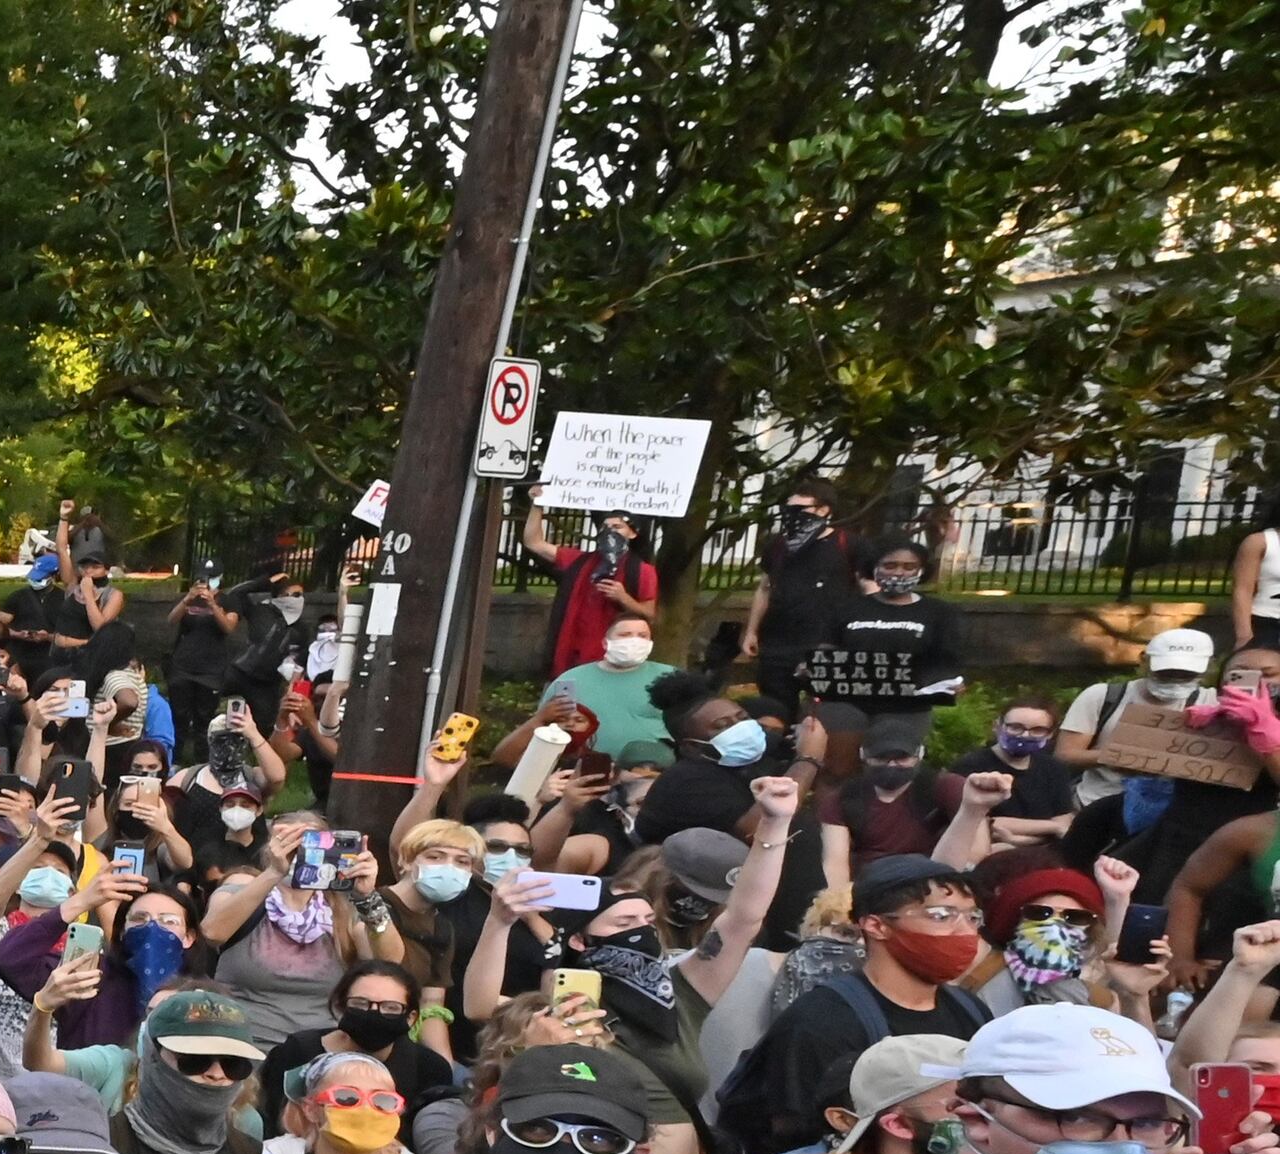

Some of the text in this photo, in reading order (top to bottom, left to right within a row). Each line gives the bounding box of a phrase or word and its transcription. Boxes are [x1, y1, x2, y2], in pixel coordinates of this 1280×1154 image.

[564, 422, 612, 444] When
[647, 432, 687, 451] power
[585, 445, 662, 465] of the people
[576, 461, 646, 478] is equal to
[586, 479, 640, 493] entrusted
[642, 482, 669, 495] with
[559, 490, 596, 506] there
[605, 497, 617, 507] is
[382, 530, 412, 554] 40
[381, 555, 396, 576] A
[811, 650, 912, 666] ANGRY
[810, 666, 912, 681] BLACK
[810, 680, 918, 696] WOMAN
[1108, 747, 1242, 783] JUSTICE
